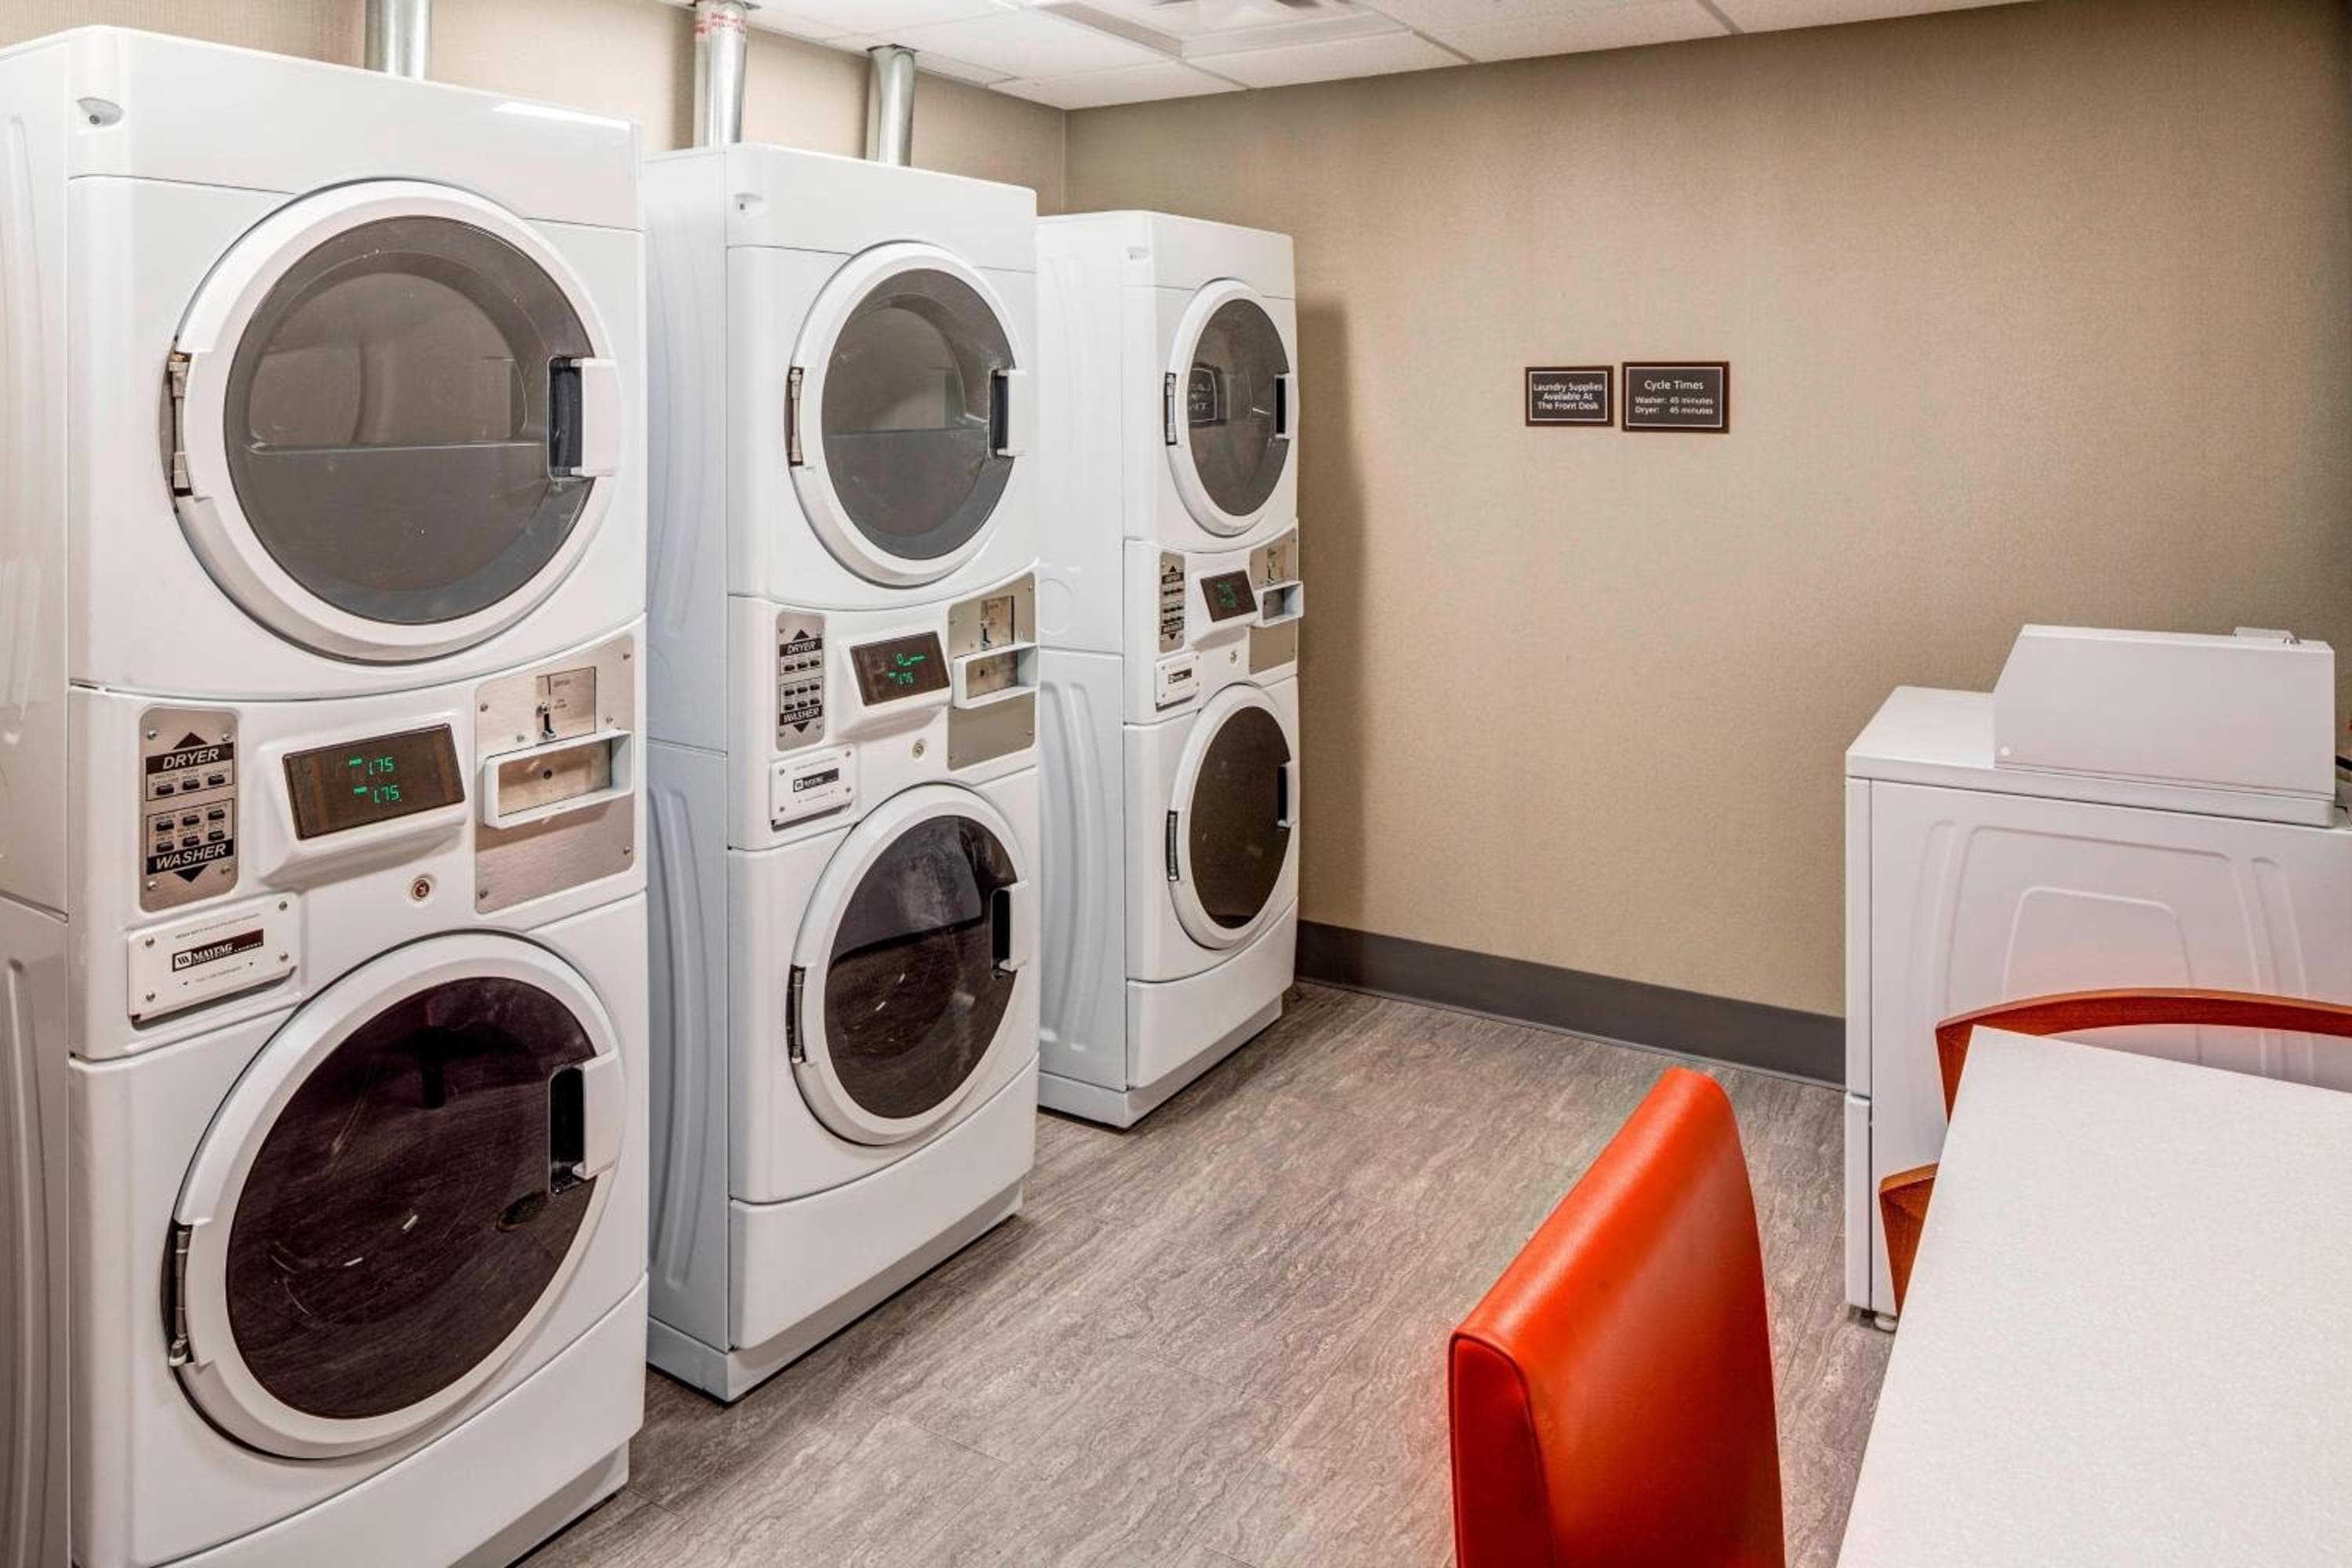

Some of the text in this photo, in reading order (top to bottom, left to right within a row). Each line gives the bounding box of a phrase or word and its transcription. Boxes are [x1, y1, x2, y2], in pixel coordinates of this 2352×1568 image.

[1534, 382, 1603, 393] Laundry Supplies
[1644, 379, 1704, 391] Cycle Times
[1543, 391, 1581, 400] Available
[1538, 401, 1599, 410] The Front Desk
[1669, 405, 1679, 414] 45
[1681, 406, 1713, 415] minutes
[786, 641, 816, 655] DRYER
[783, 707, 820, 724] WASHER
[162, 747, 220, 771] DRYER
[155, 842, 226, 870] WASHER
